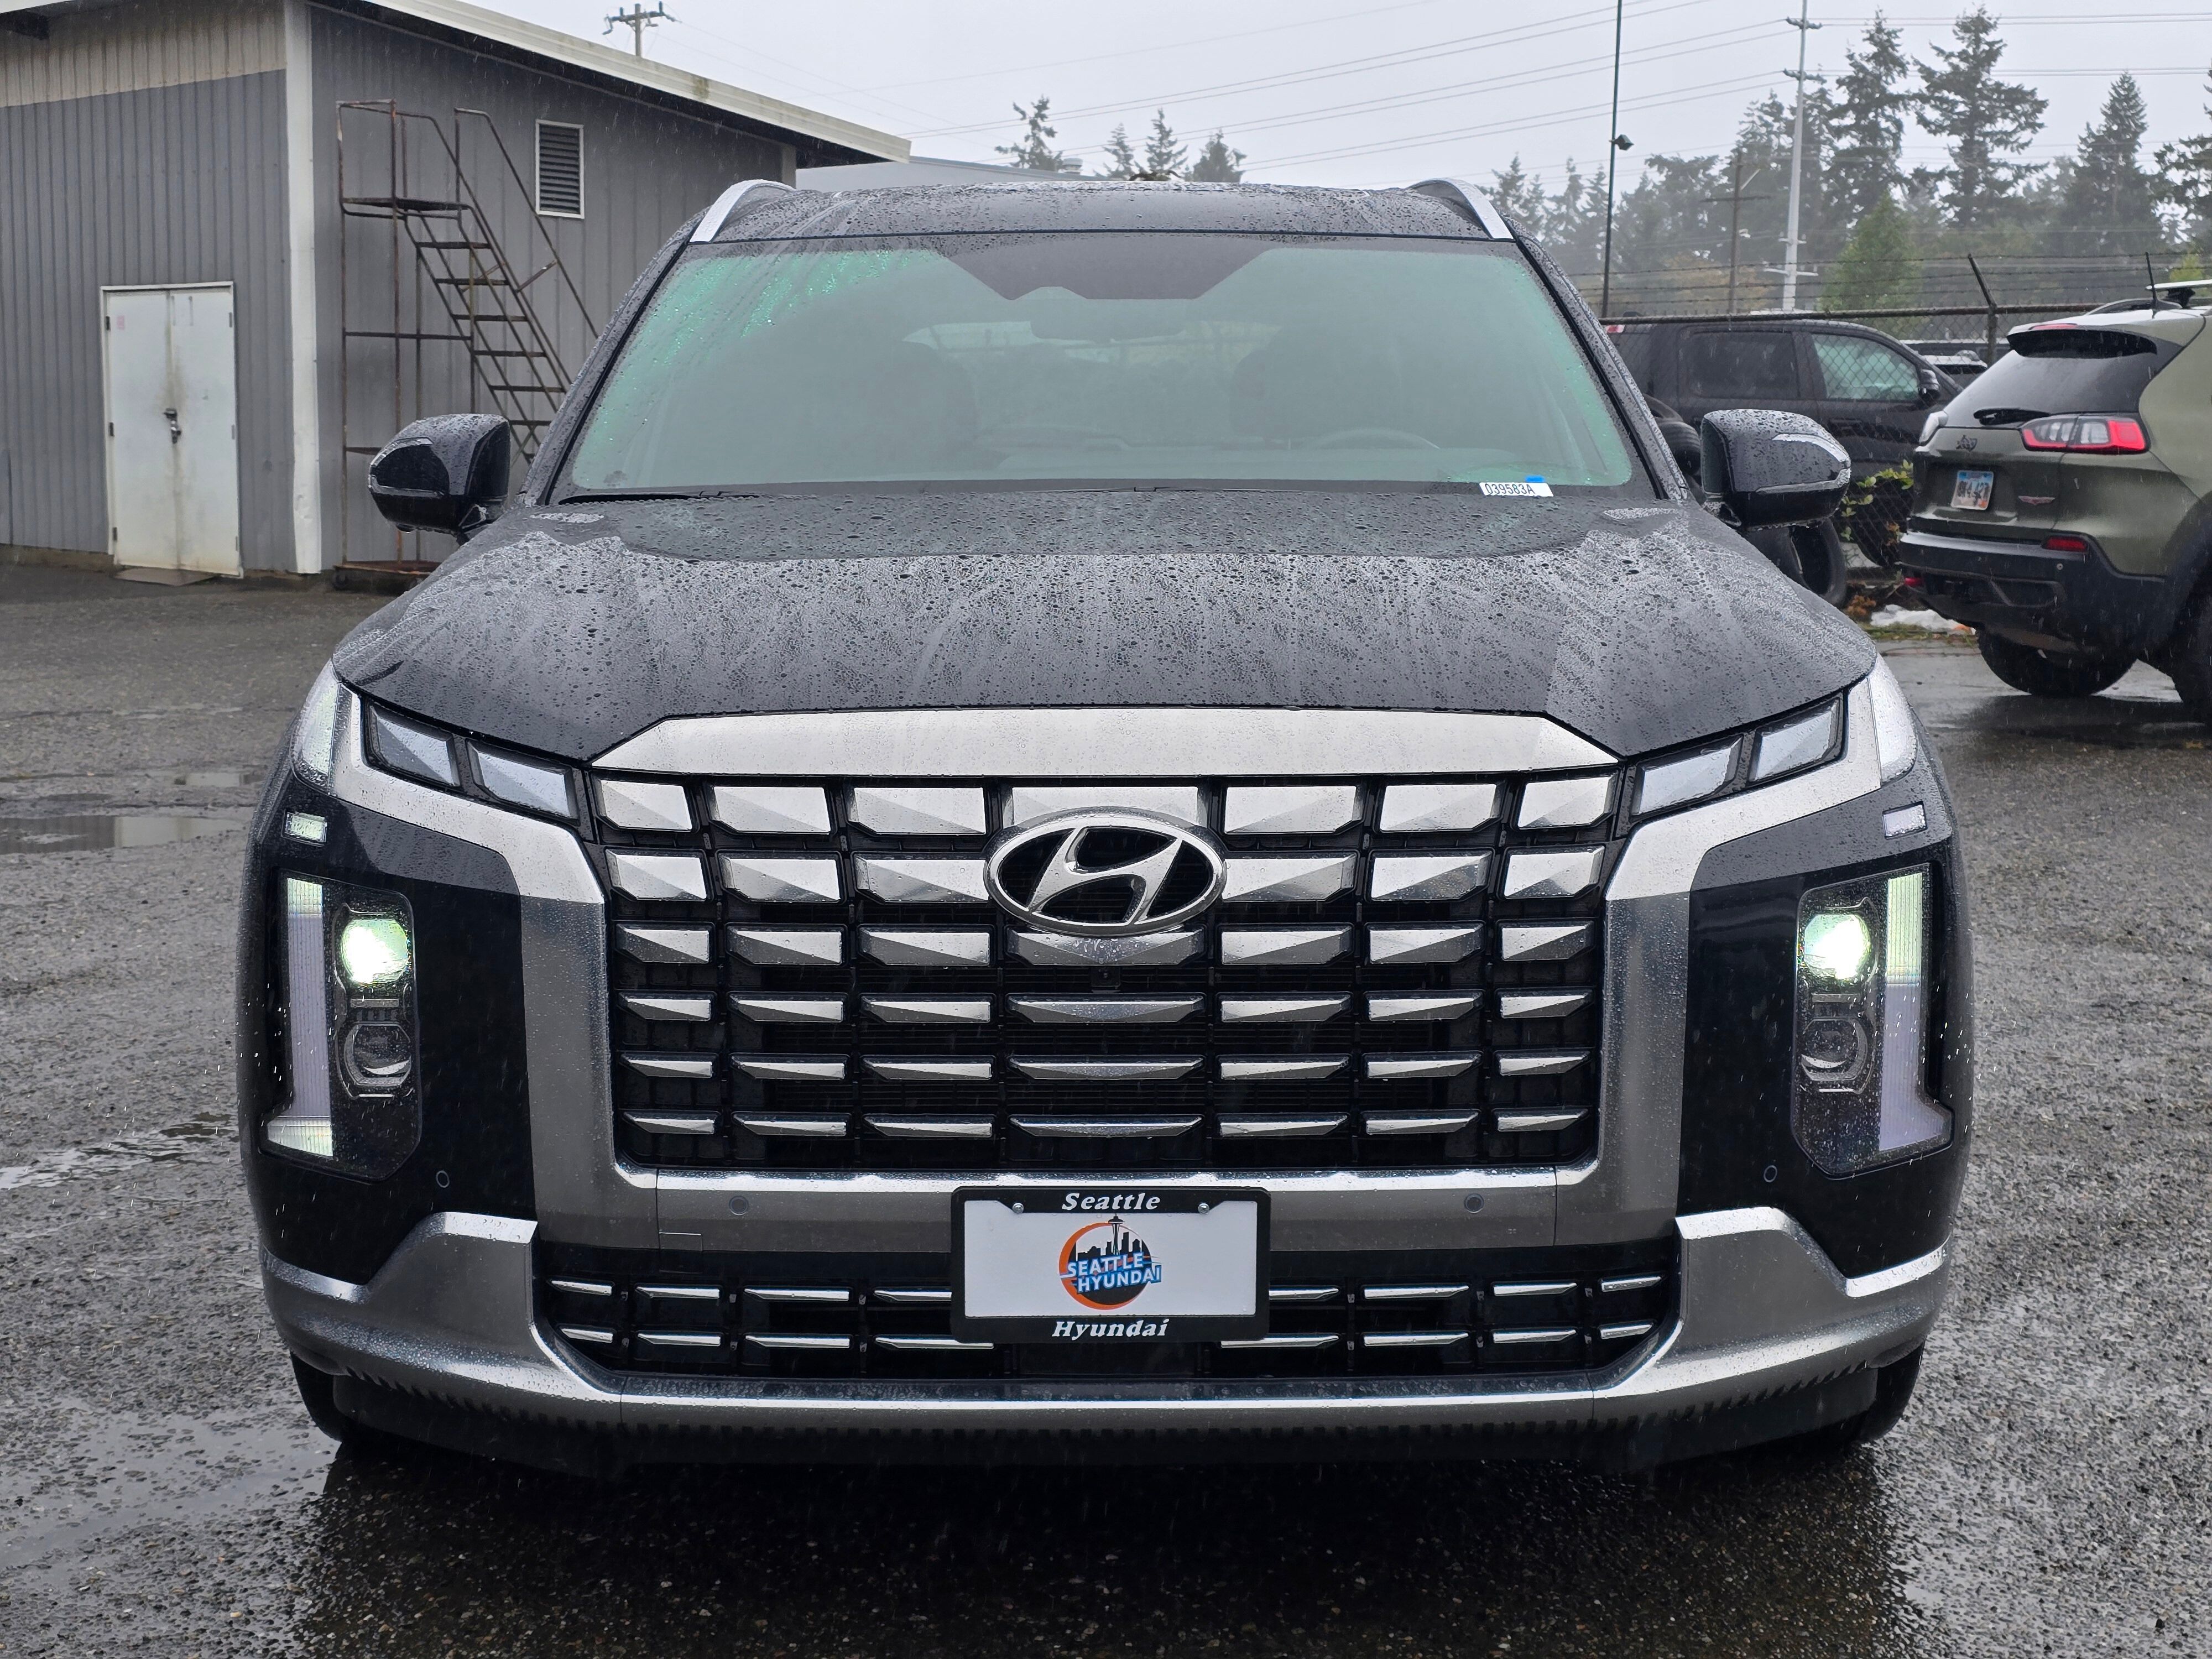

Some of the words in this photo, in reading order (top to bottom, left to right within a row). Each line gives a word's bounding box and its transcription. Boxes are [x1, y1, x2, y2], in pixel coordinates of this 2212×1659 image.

[1484, 483, 1536, 494] 039583A
[1062, 1193, 1161, 1211] Seattle
[1067, 1252, 1144, 1277] SEATTLE
[1078, 1266, 1161, 1292] HYUNDAI
[1051, 1318, 1170, 1340] Hyundai
